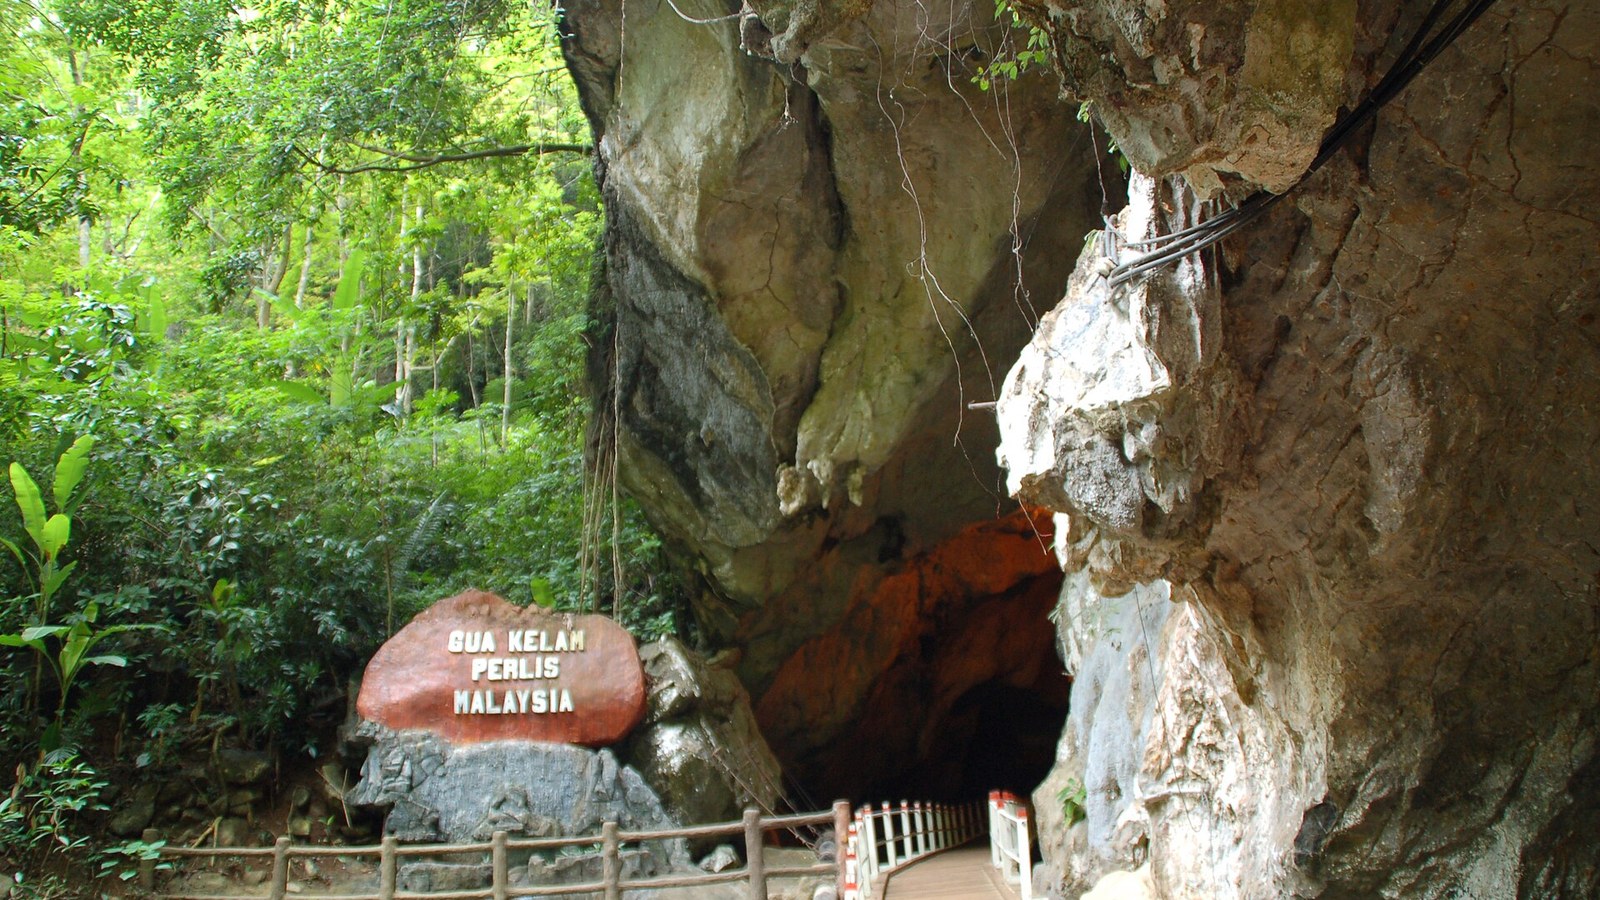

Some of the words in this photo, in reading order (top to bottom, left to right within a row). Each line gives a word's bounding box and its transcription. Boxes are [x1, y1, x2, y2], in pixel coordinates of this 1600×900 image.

[448, 630, 495, 653] GUA
[508, 629, 584, 653] KELAM
[472, 657, 560, 681] PERLIS
[453, 688, 574, 714] MALAYSIA
